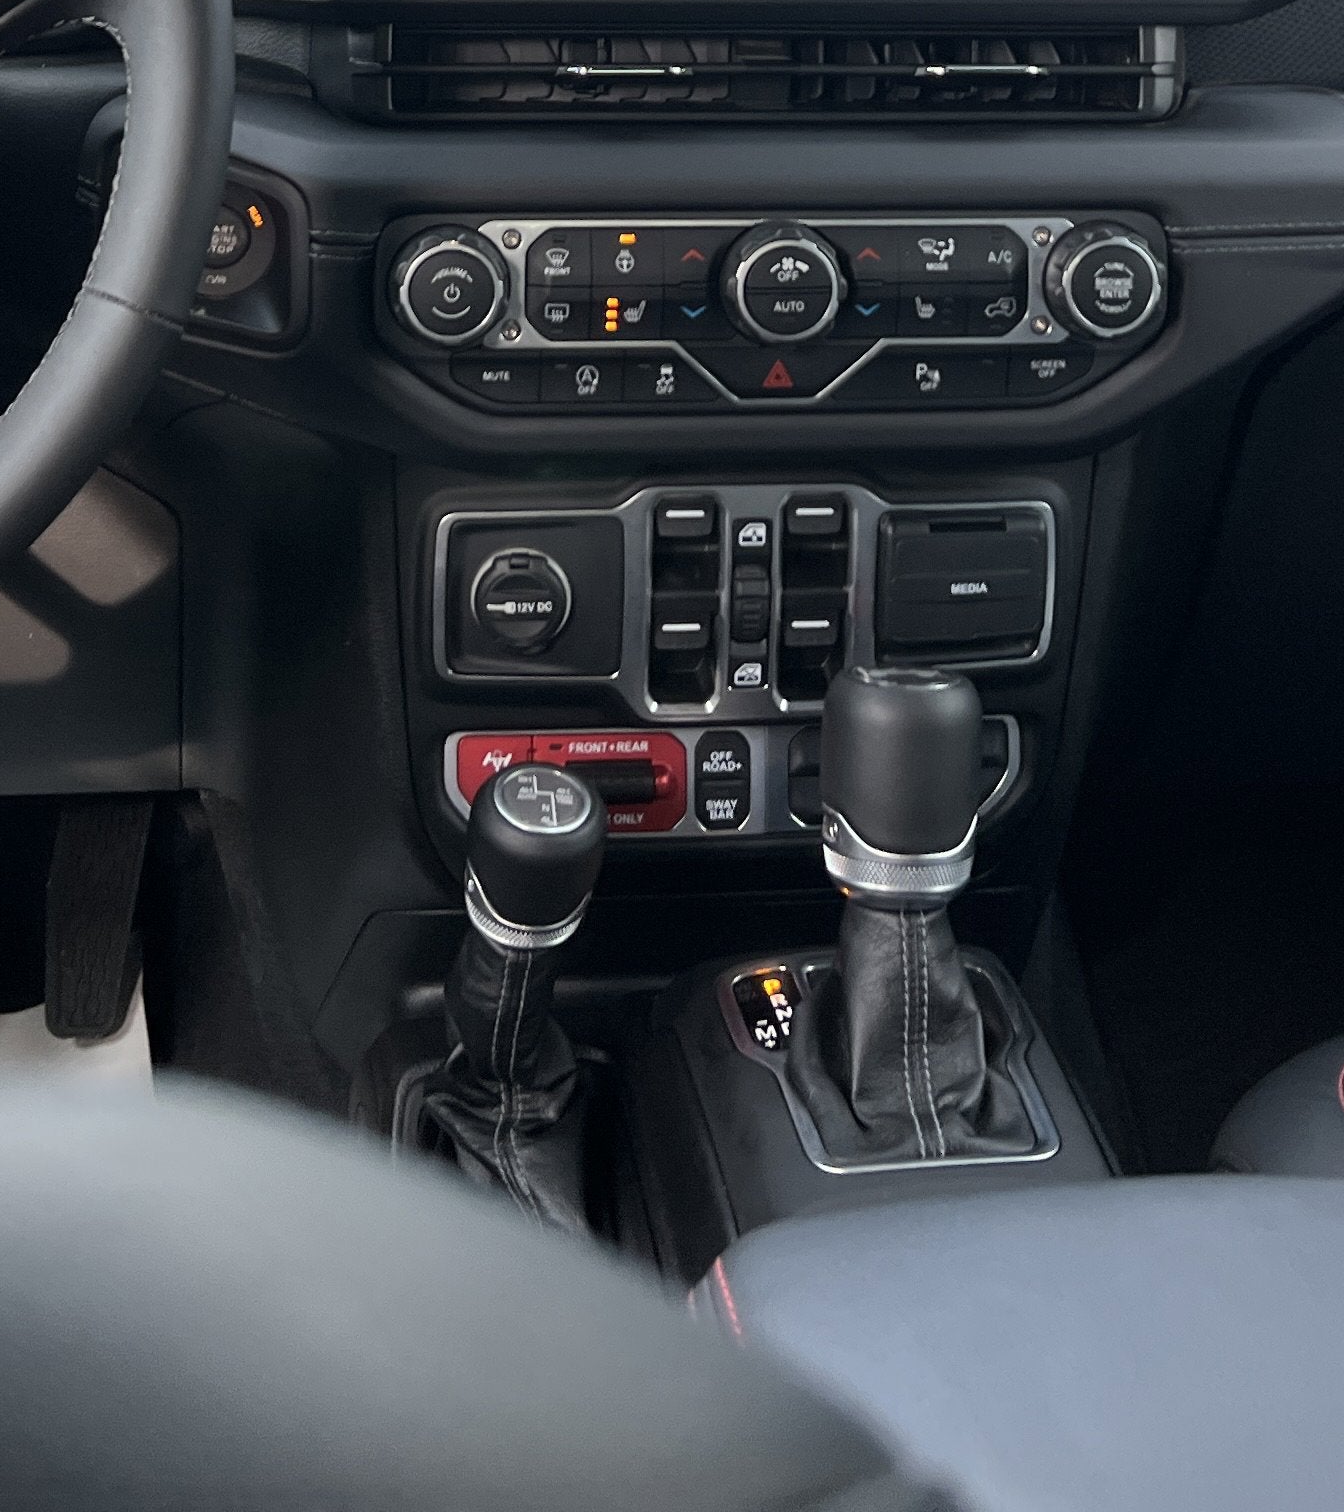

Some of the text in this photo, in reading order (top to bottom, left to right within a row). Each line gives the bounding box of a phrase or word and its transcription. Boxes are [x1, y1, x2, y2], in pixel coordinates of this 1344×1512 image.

[987, 251, 1013, 264] A/C
[777, 270, 799, 282] OFF
[773, 300, 805, 312] AUTO
[1030, 360, 1066, 370] SCREEN
[482, 371, 510, 381] MUTE
[1038, 369, 1055, 378] OFF
[578, 385, 596, 395] OFF
[951, 582, 988, 594] MEDIA
[537, 601, 553, 613] DC
[710, 751, 733, 762] OFF
[705, 799, 737, 811] SWAY
[613, 814, 643, 825] ONLY
[709, 809, 734, 820] BAR
[764, 979, 782, 996] P
[770, 993, 788, 1008] R
[776, 1006, 792, 1021] N
[755, 1025, 777, 1041] M
